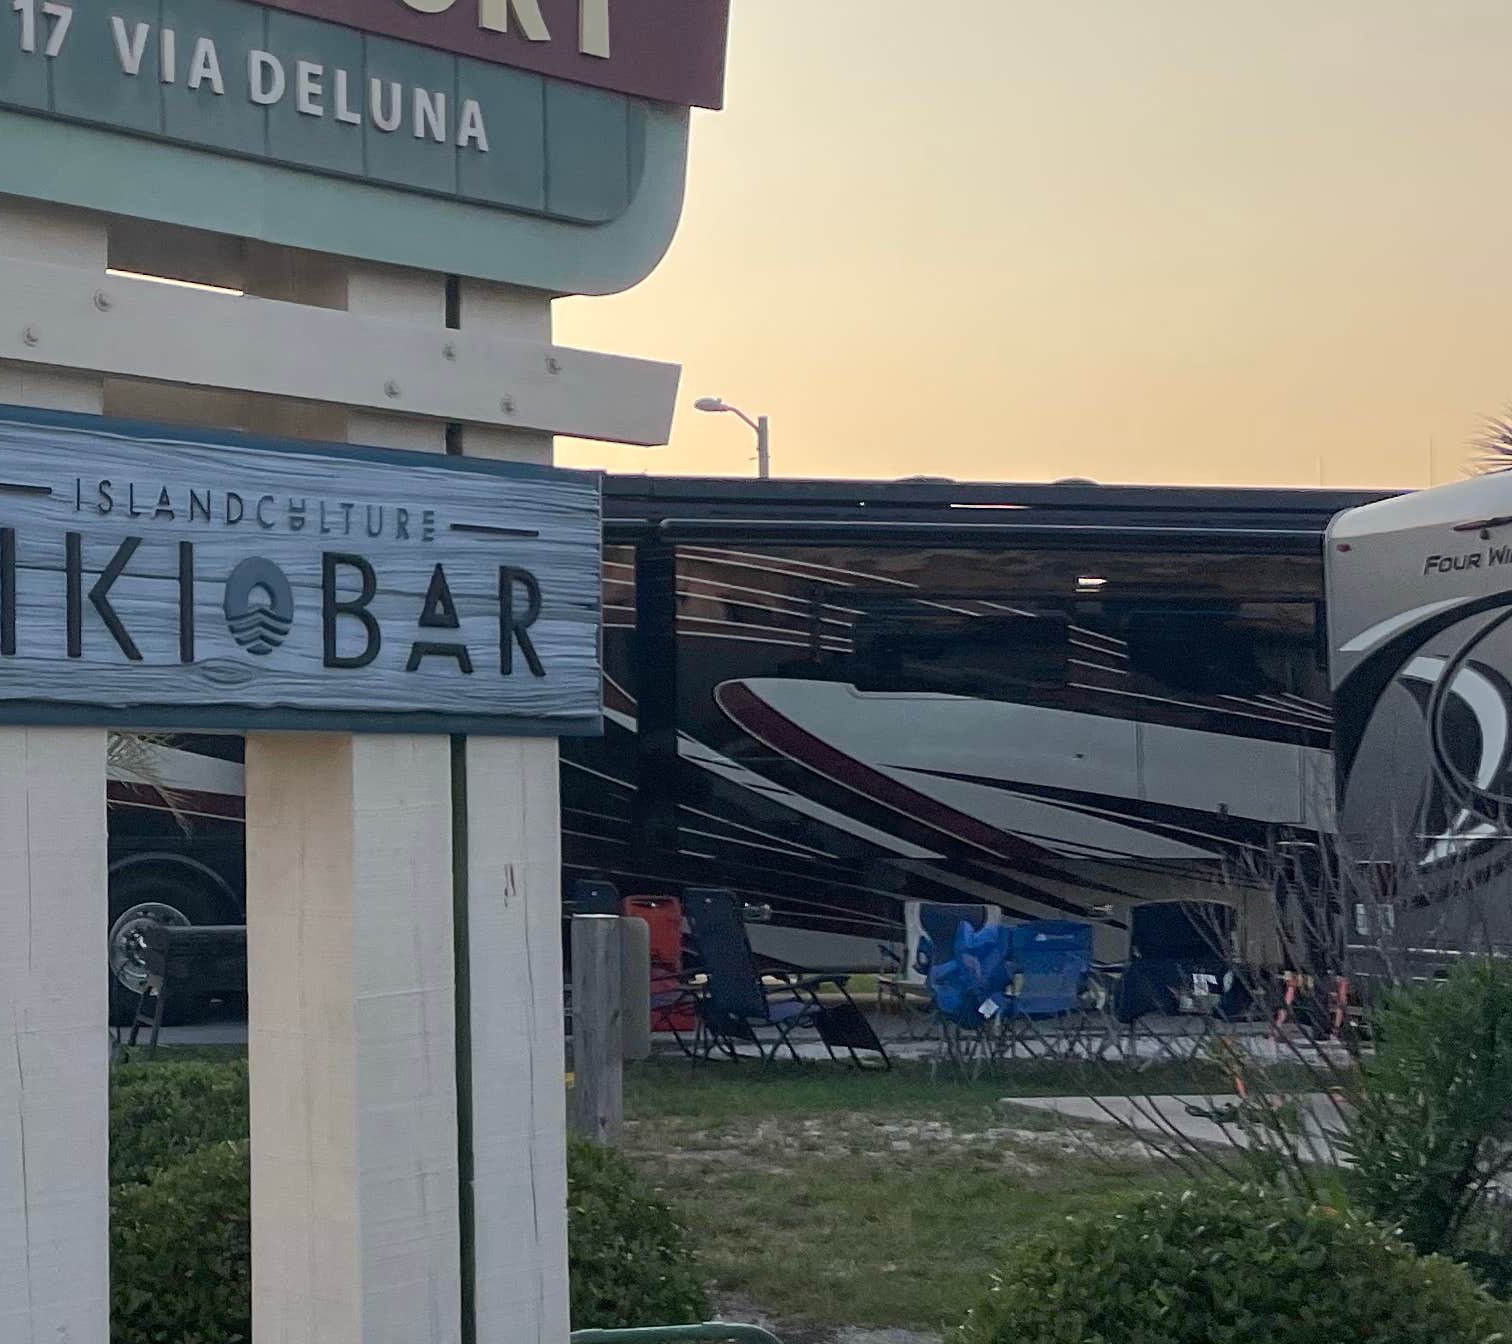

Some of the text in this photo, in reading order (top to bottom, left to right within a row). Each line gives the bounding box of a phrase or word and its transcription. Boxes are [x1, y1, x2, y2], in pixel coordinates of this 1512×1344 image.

[112, 15, 225, 97] VIA
[247, 48, 489, 153] DELUNA
[322, 551, 546, 677] BAR
